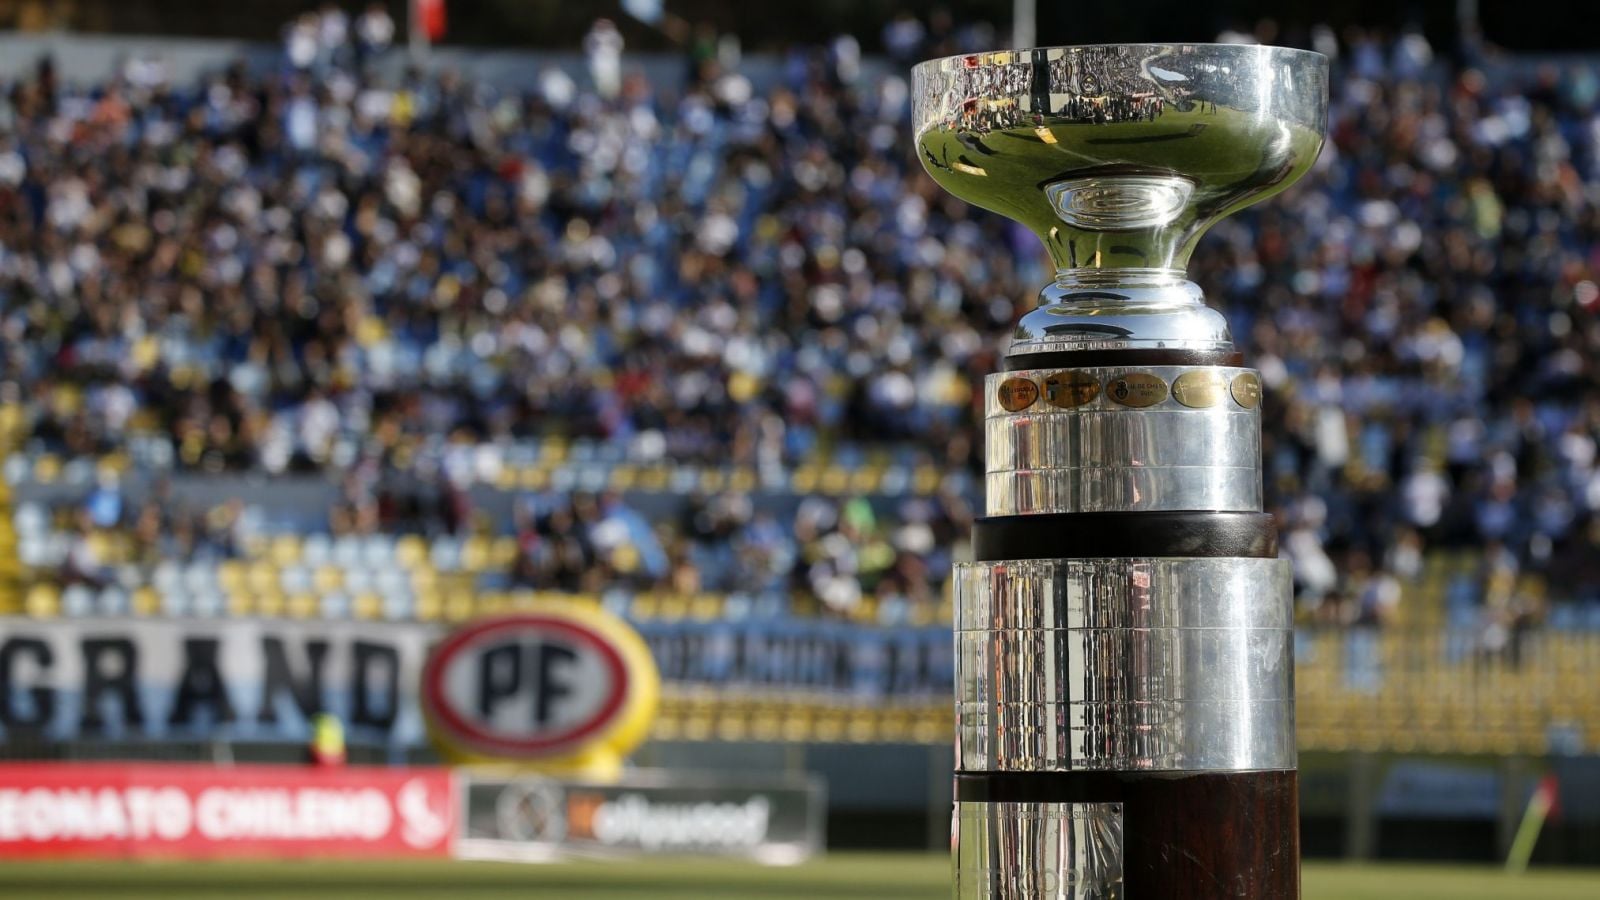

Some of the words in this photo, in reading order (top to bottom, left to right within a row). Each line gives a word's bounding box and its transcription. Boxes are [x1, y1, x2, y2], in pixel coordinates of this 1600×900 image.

[0, 636, 400, 732] GRAND
[479, 640, 579, 727] PF
[196, 785, 392, 841] CHILENO
